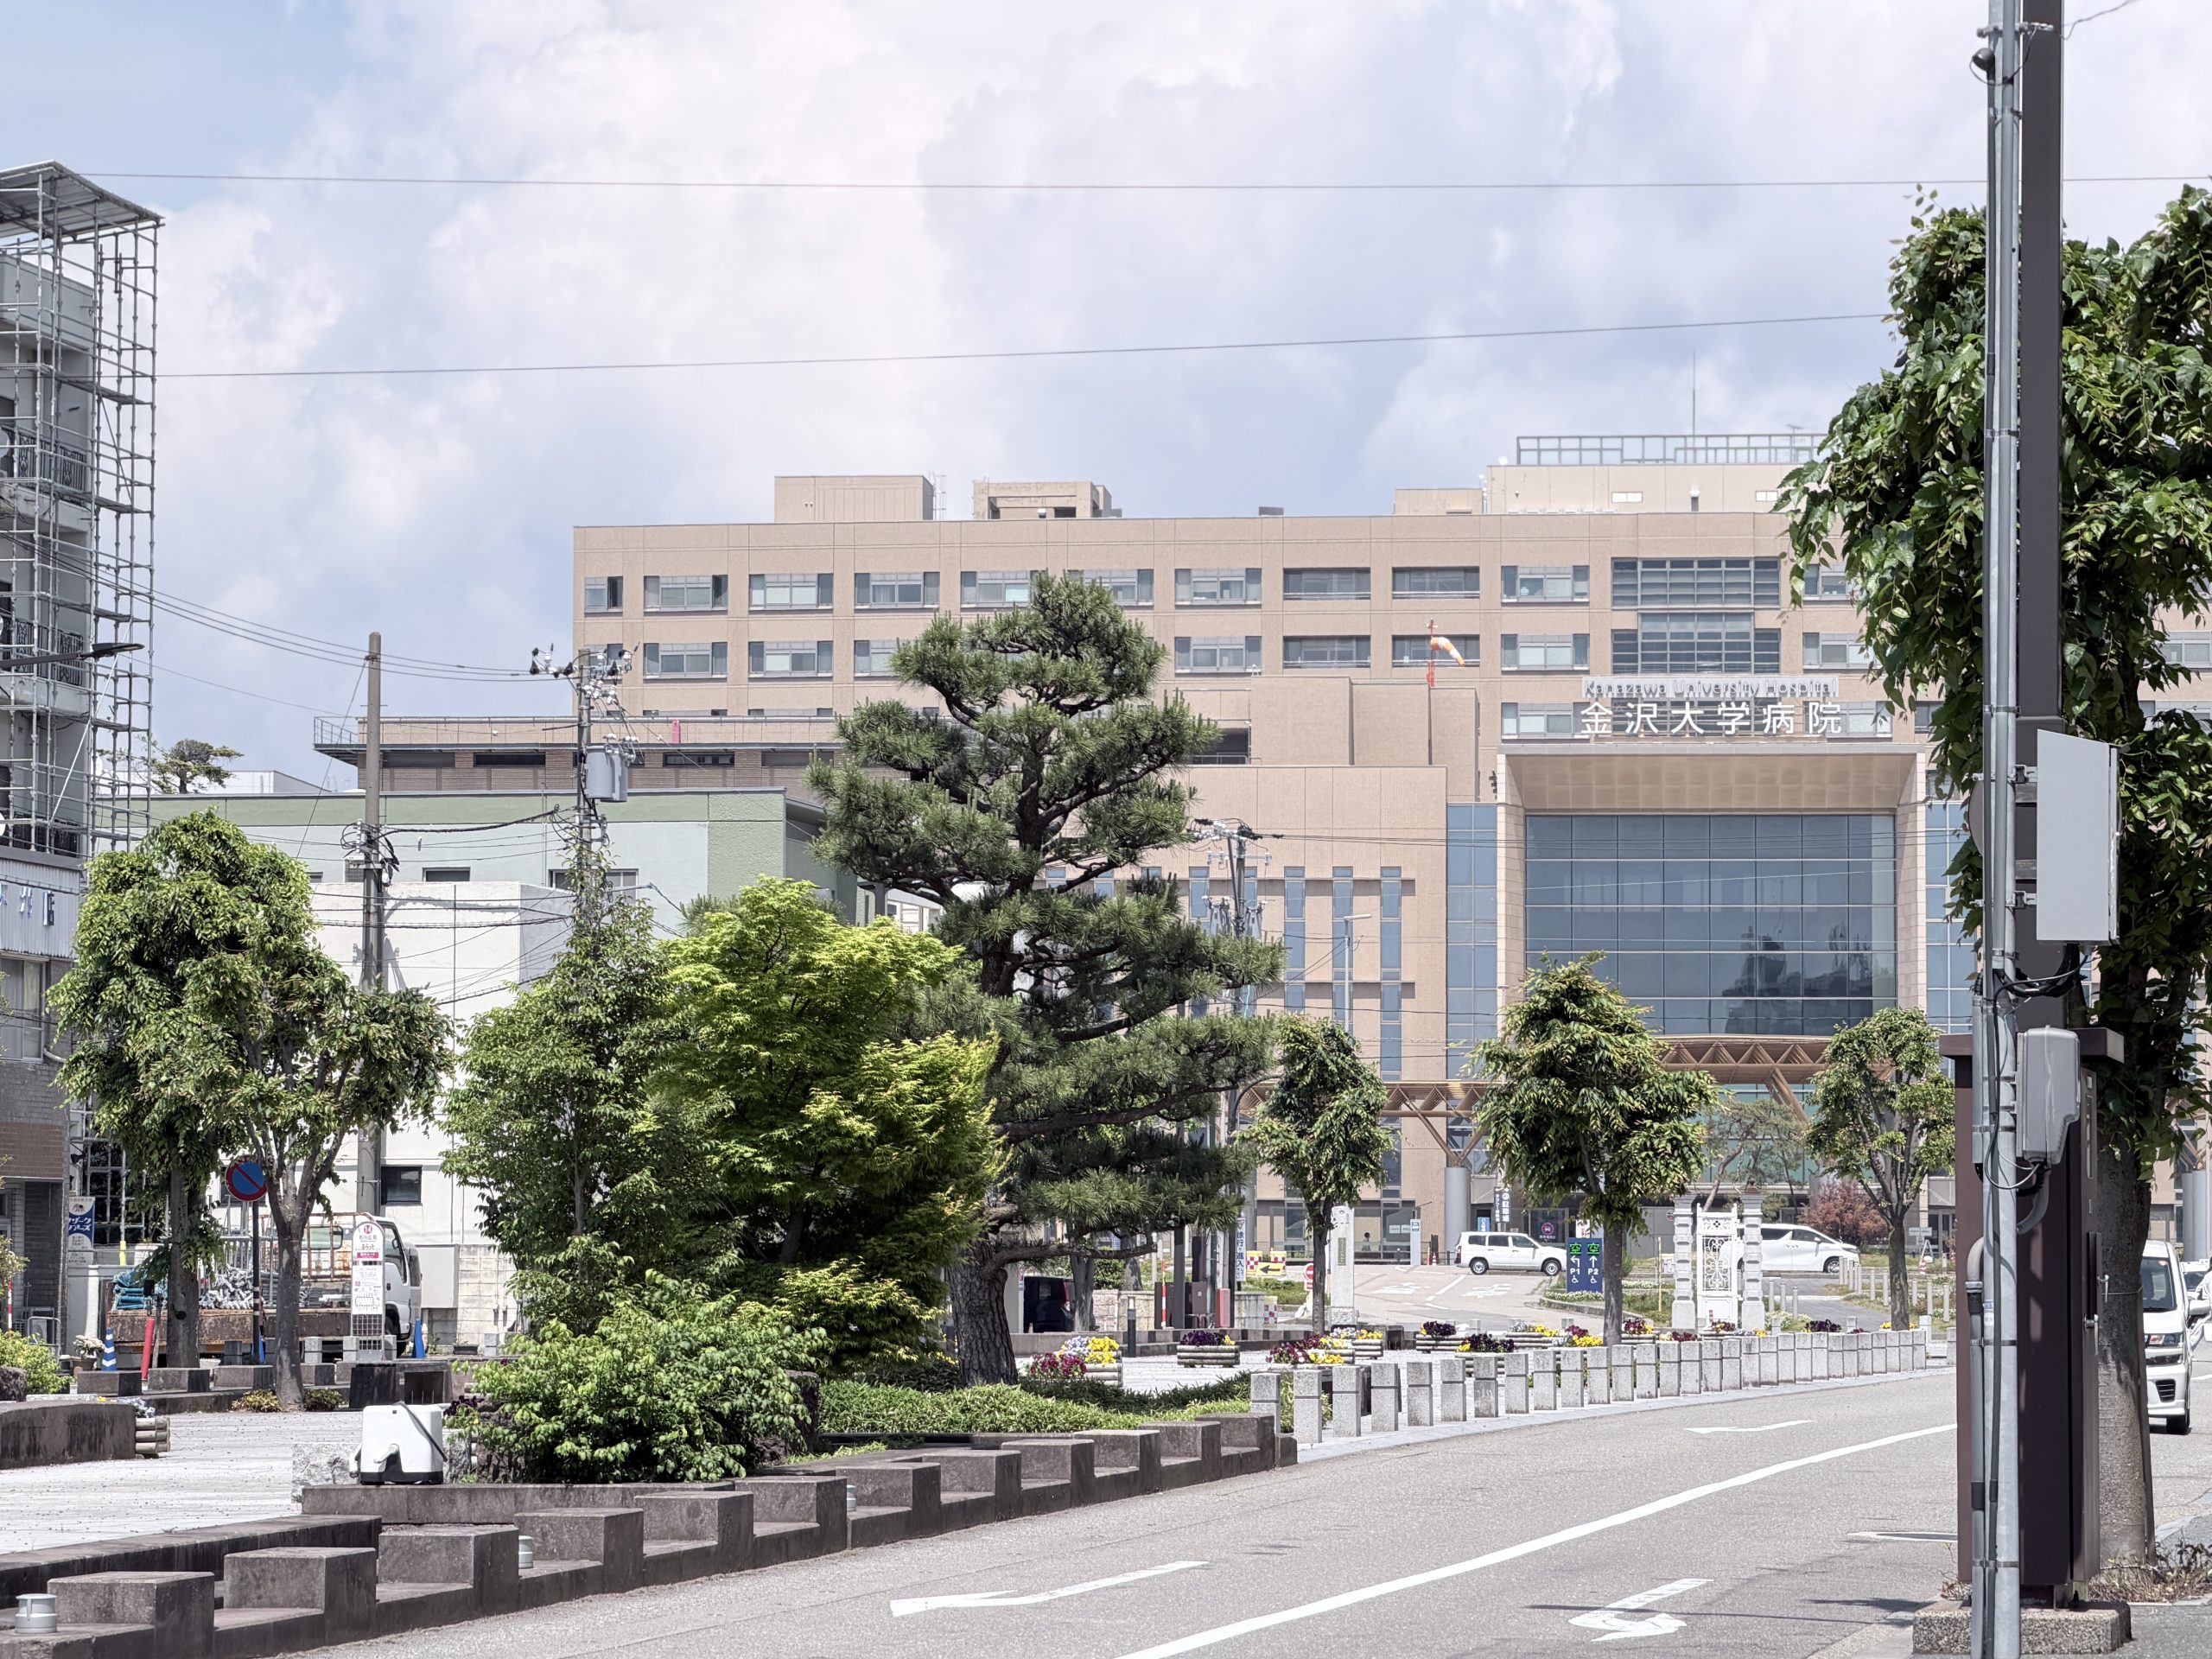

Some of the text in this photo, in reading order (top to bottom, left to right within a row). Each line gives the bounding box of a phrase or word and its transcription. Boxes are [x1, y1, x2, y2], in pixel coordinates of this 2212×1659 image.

[1585, 678, 1837, 696] Kanazawa University Hospital
[1580, 702, 1841, 734] 金沢大学病院
[1570, 1243, 1582, 1255] 空
[1587, 1243, 1599, 1255] 空
